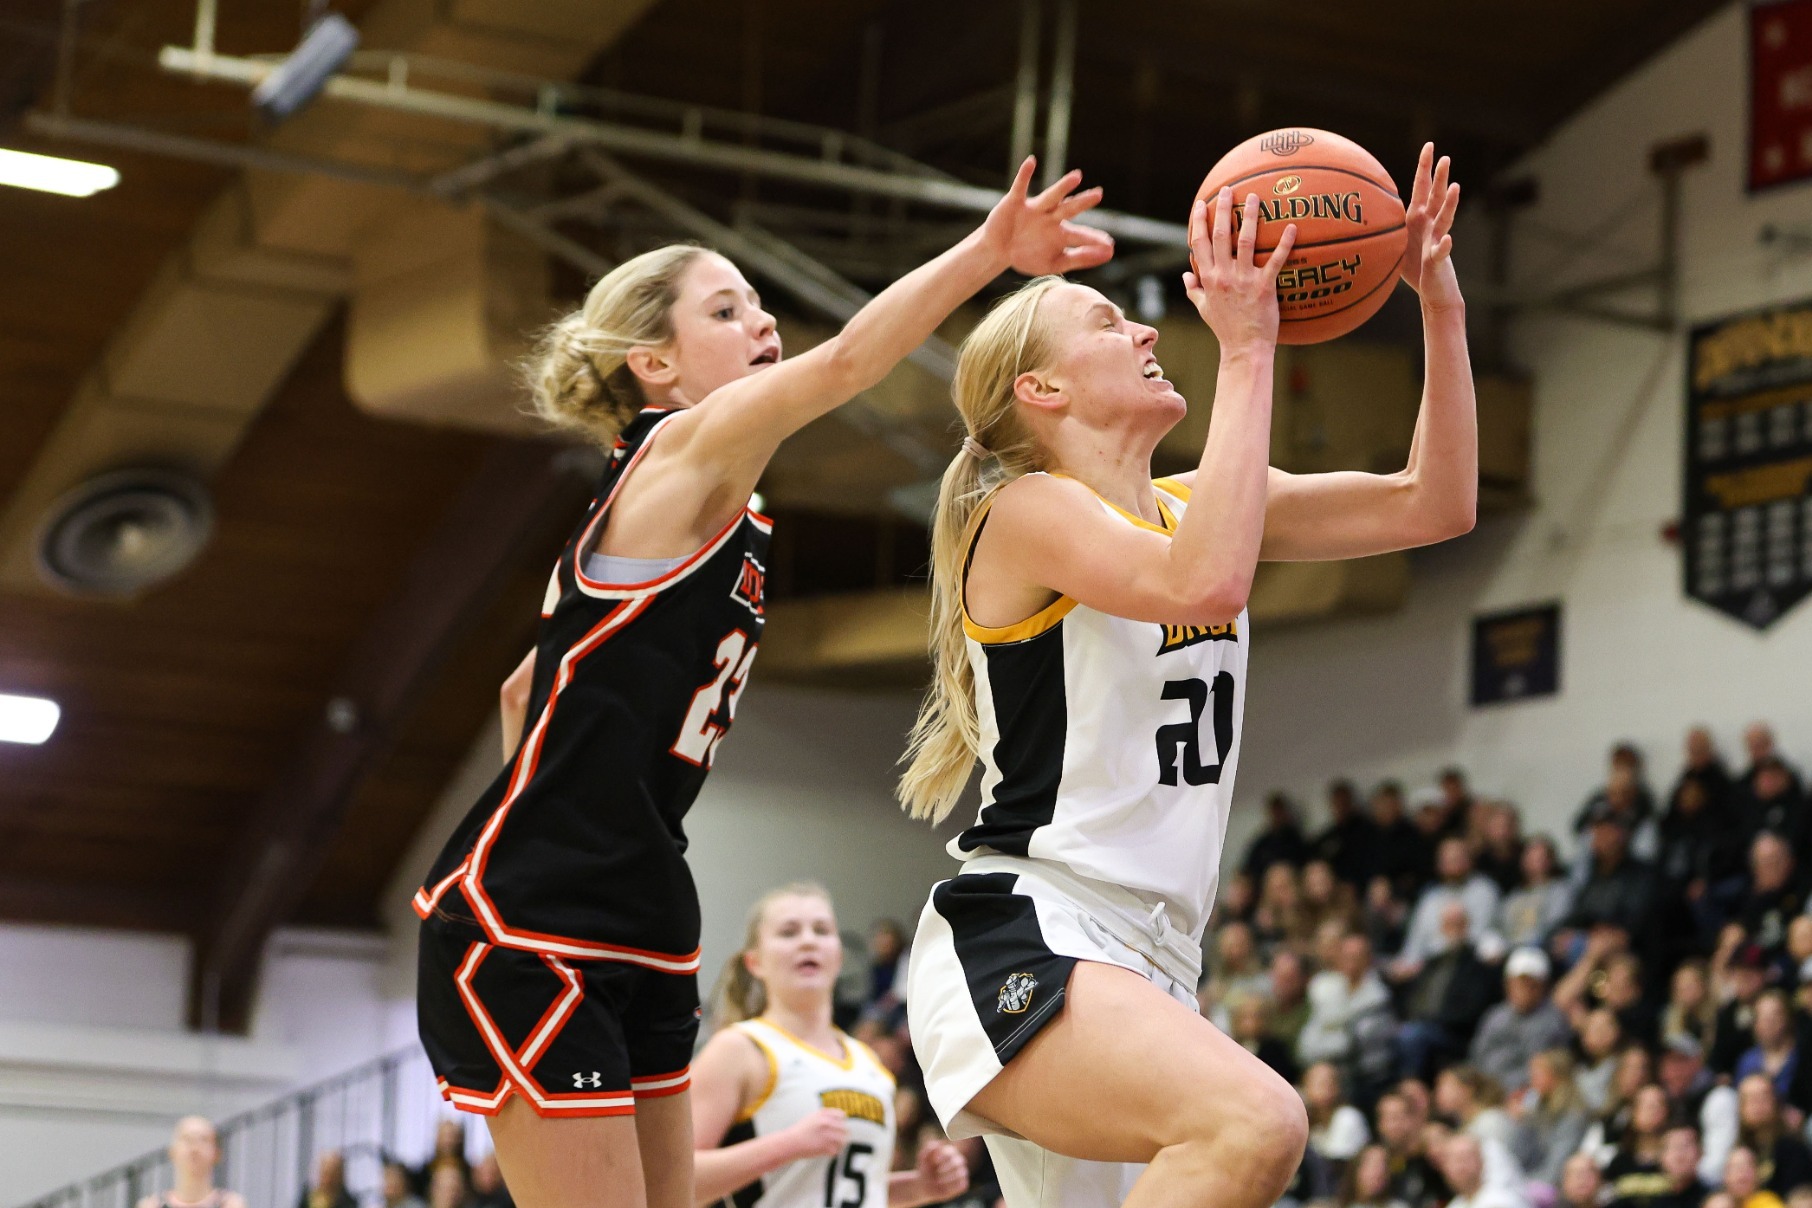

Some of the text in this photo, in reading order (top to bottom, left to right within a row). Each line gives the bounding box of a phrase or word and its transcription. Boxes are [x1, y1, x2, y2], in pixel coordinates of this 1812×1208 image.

[1230, 192, 1362, 234] ALDING
[1276, 254, 1361, 289] GACY
[1155, 670, 1235, 787] 20
[824, 1142, 874, 1208] 15
